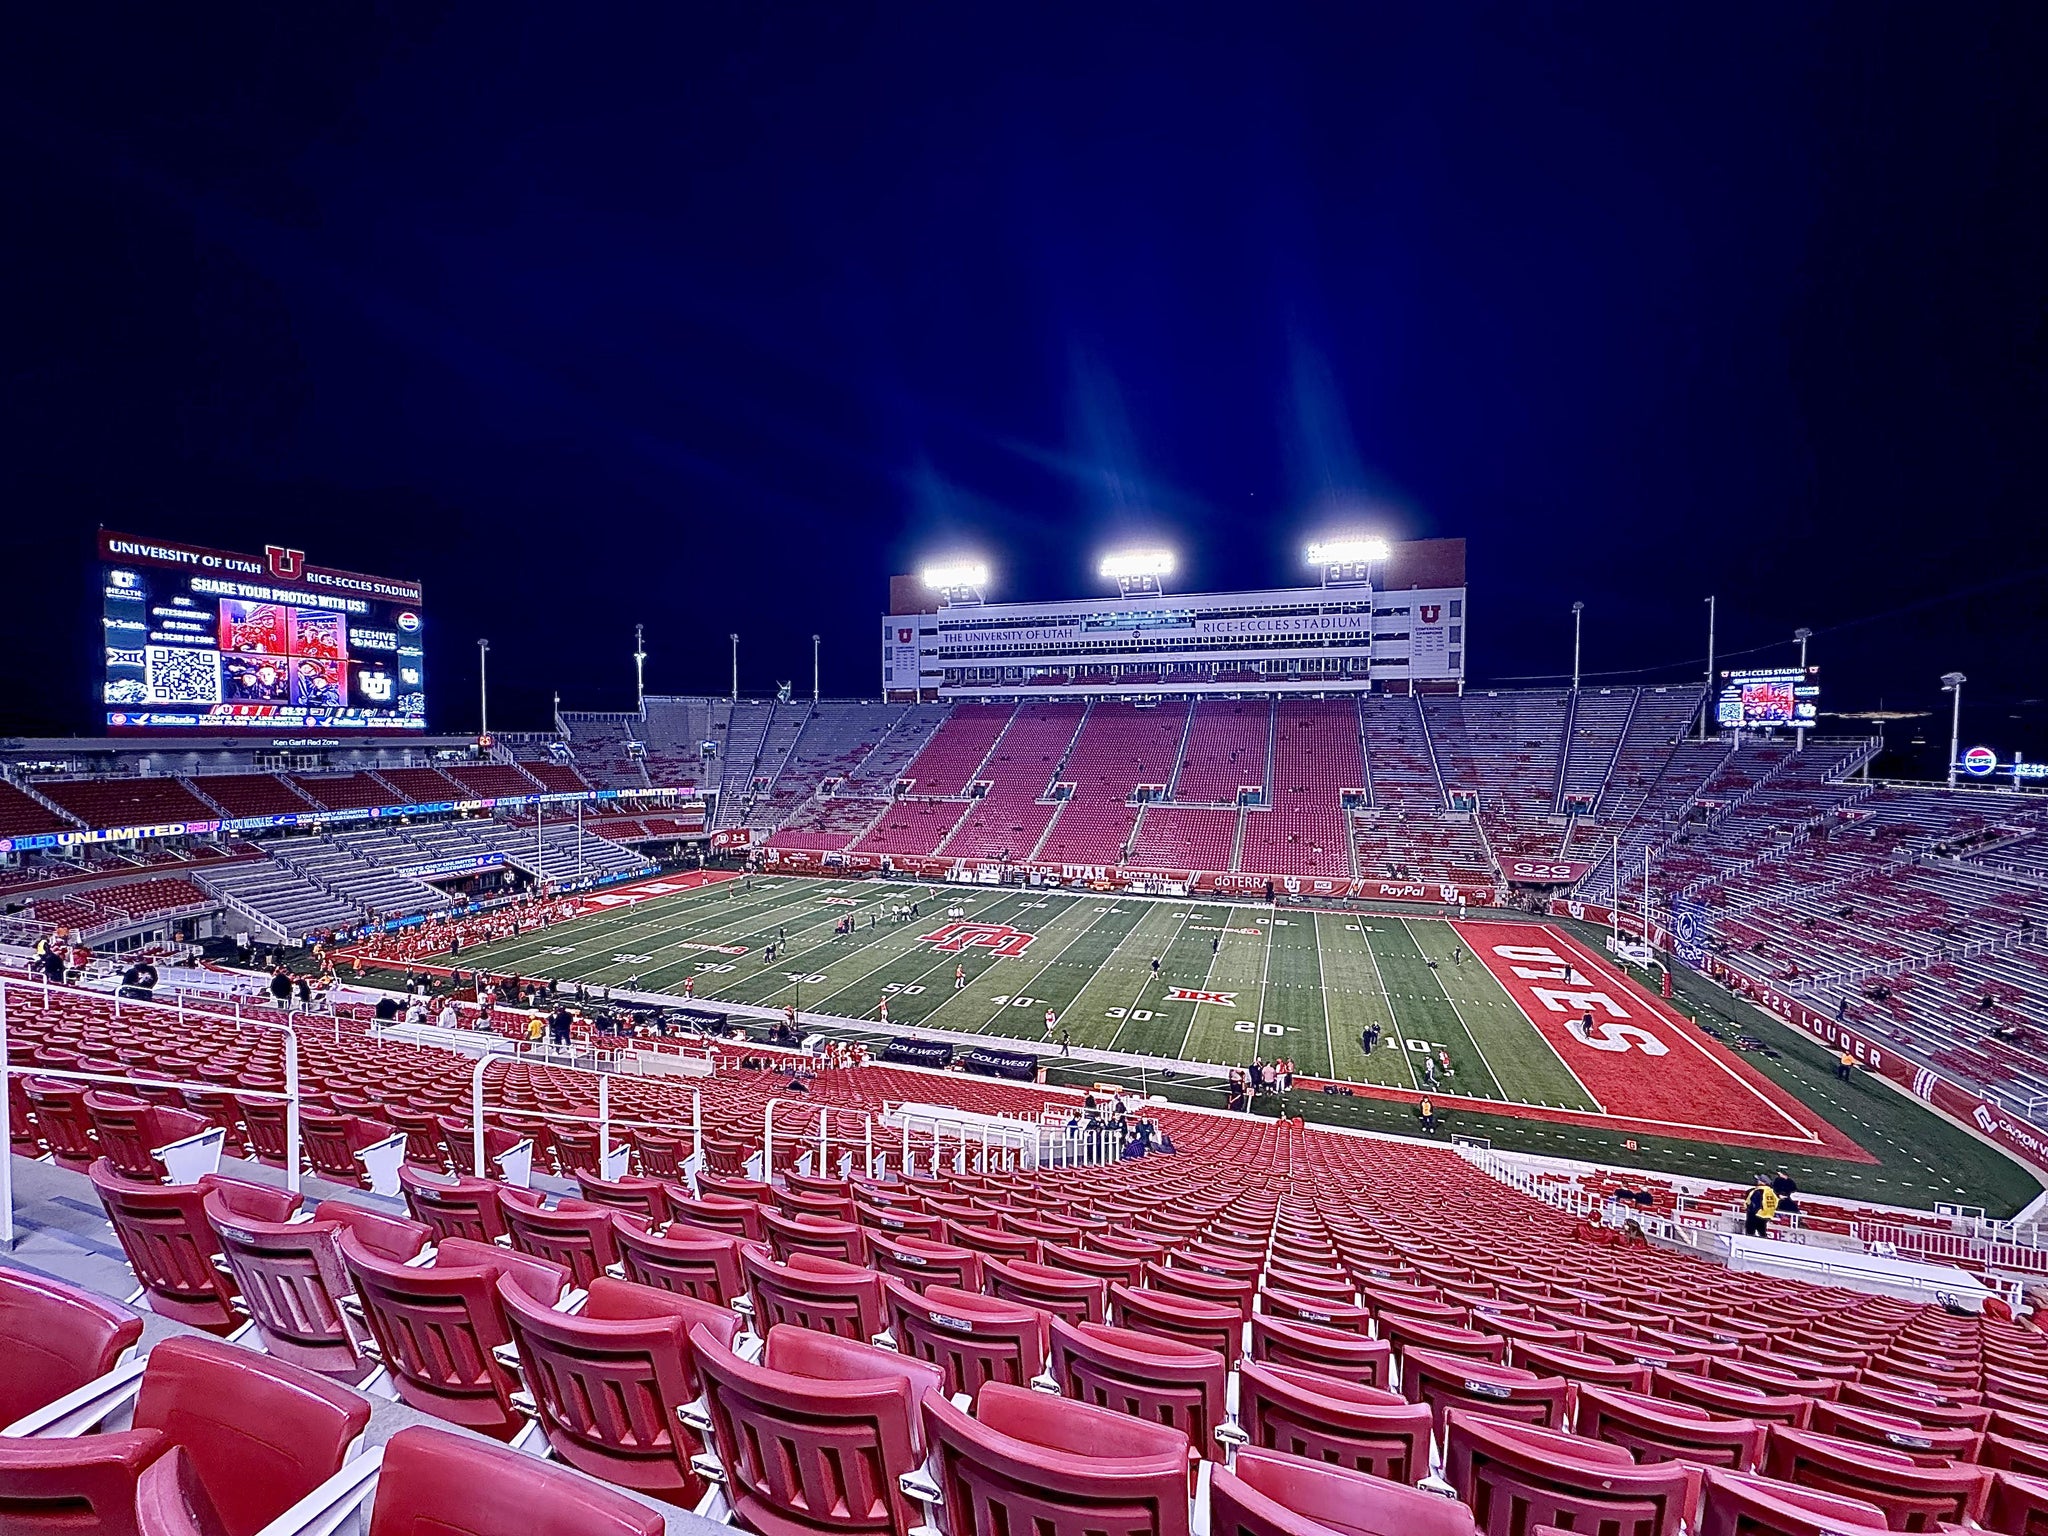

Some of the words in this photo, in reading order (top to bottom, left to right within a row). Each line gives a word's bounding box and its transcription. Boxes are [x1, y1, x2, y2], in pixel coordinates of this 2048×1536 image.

[109, 540, 199, 563] UNIVERSITY
[202, 556, 222, 568] OF
[225, 559, 261, 574] UTAH
[306, 572, 372, 591] RICE-ECCLES
[374, 584, 419, 598] STADIUM
[190, 577, 236, 594] SHARE
[237, 583, 271, 598] YOUR
[272, 589, 317, 605] PHOTOS
[318, 595, 345, 609] WITH
[347, 599, 366, 612] US!
[1420, 605, 1441, 624] U
[1203, 619, 1289, 633] RICE-ECCLES
[1294, 617, 1361, 630] STADIUM
[350, 628, 397, 641] BEEHIVE
[944, 633, 962, 643] THE
[965, 631, 1023, 642] UNIVERSITY
[1026, 630, 1040, 640] OF
[1043, 629, 1072, 639] UTAH
[364, 638, 397, 650] MEALS
[151, 714, 196, 724] Solitude
[617, 788, 677, 797] UNLIMITED
[381, 803, 453, 816] ICONIC
[454, 800, 482, 810] LOUD
[222, 820, 230, 830] AS
[230, 819, 243, 830] YOU
[244, 817, 265, 829] WANNA
[16, 836, 56, 850] RILED
[58, 825, 185, 846] UNLIMITED
[1062, 865, 1106, 879] UTAH
[1514, 863, 1571, 875] G2G
[1379, 885, 1425, 897] PayPal
[882, 983, 926, 995] 50
[990, 995, 1036, 1008] 40
[1492, 945, 1670, 1056] UTES
[1104, 1006, 1154, 1022] 30
[1234, 1020, 1284, 1037] 20
[1762, 990, 1792, 1017] 22%
[1802, 1011, 1881, 1068] LOUDER
[889, 1043, 916, 1054] COLE
[1384, 1036, 1431, 1053] 10
[971, 1053, 1001, 1065] COLE
[1001, 1058, 1032, 1068] WEST
[1999, 1119, 2038, 1151] CANYON
